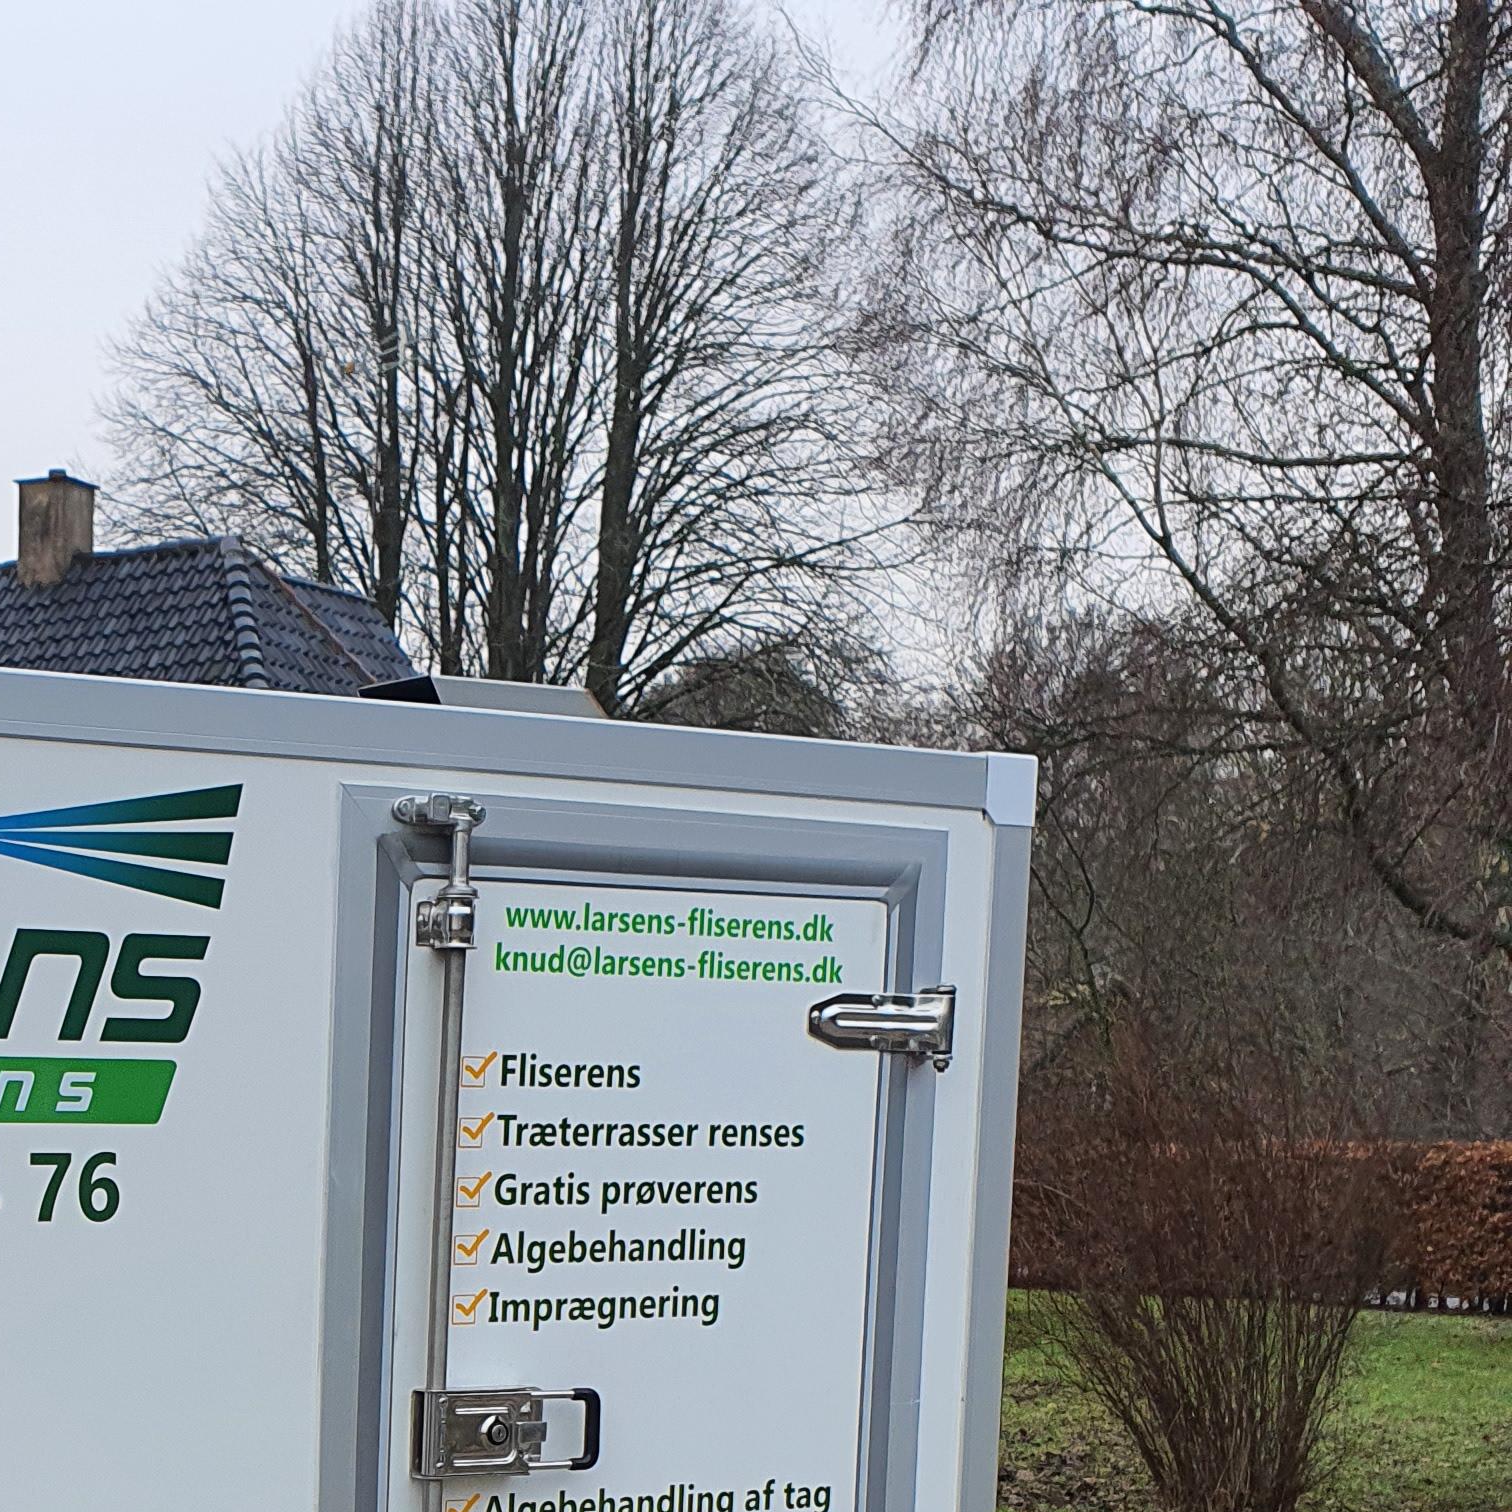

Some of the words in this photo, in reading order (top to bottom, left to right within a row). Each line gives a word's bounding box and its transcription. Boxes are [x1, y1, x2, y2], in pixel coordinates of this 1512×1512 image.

[504, 902, 834, 943] www.larsens-fliserens.dk
[493, 942, 844, 985] knud@larsens-fliserens.dk
[500, 1052, 641, 1089] Fliserens
[497, 1114, 699, 1147] Træterrasser
[708, 1124, 804, 1148] renses
[29, 1151, 120, 1223] 76
[494, 1171, 590, 1206] Gratis
[601, 1181, 758, 1215] prøverens
[490, 1228, 746, 1274] Algebehandling
[488, 1285, 720, 1332] Imprægnering
[745, 1478, 776, 1512] af
